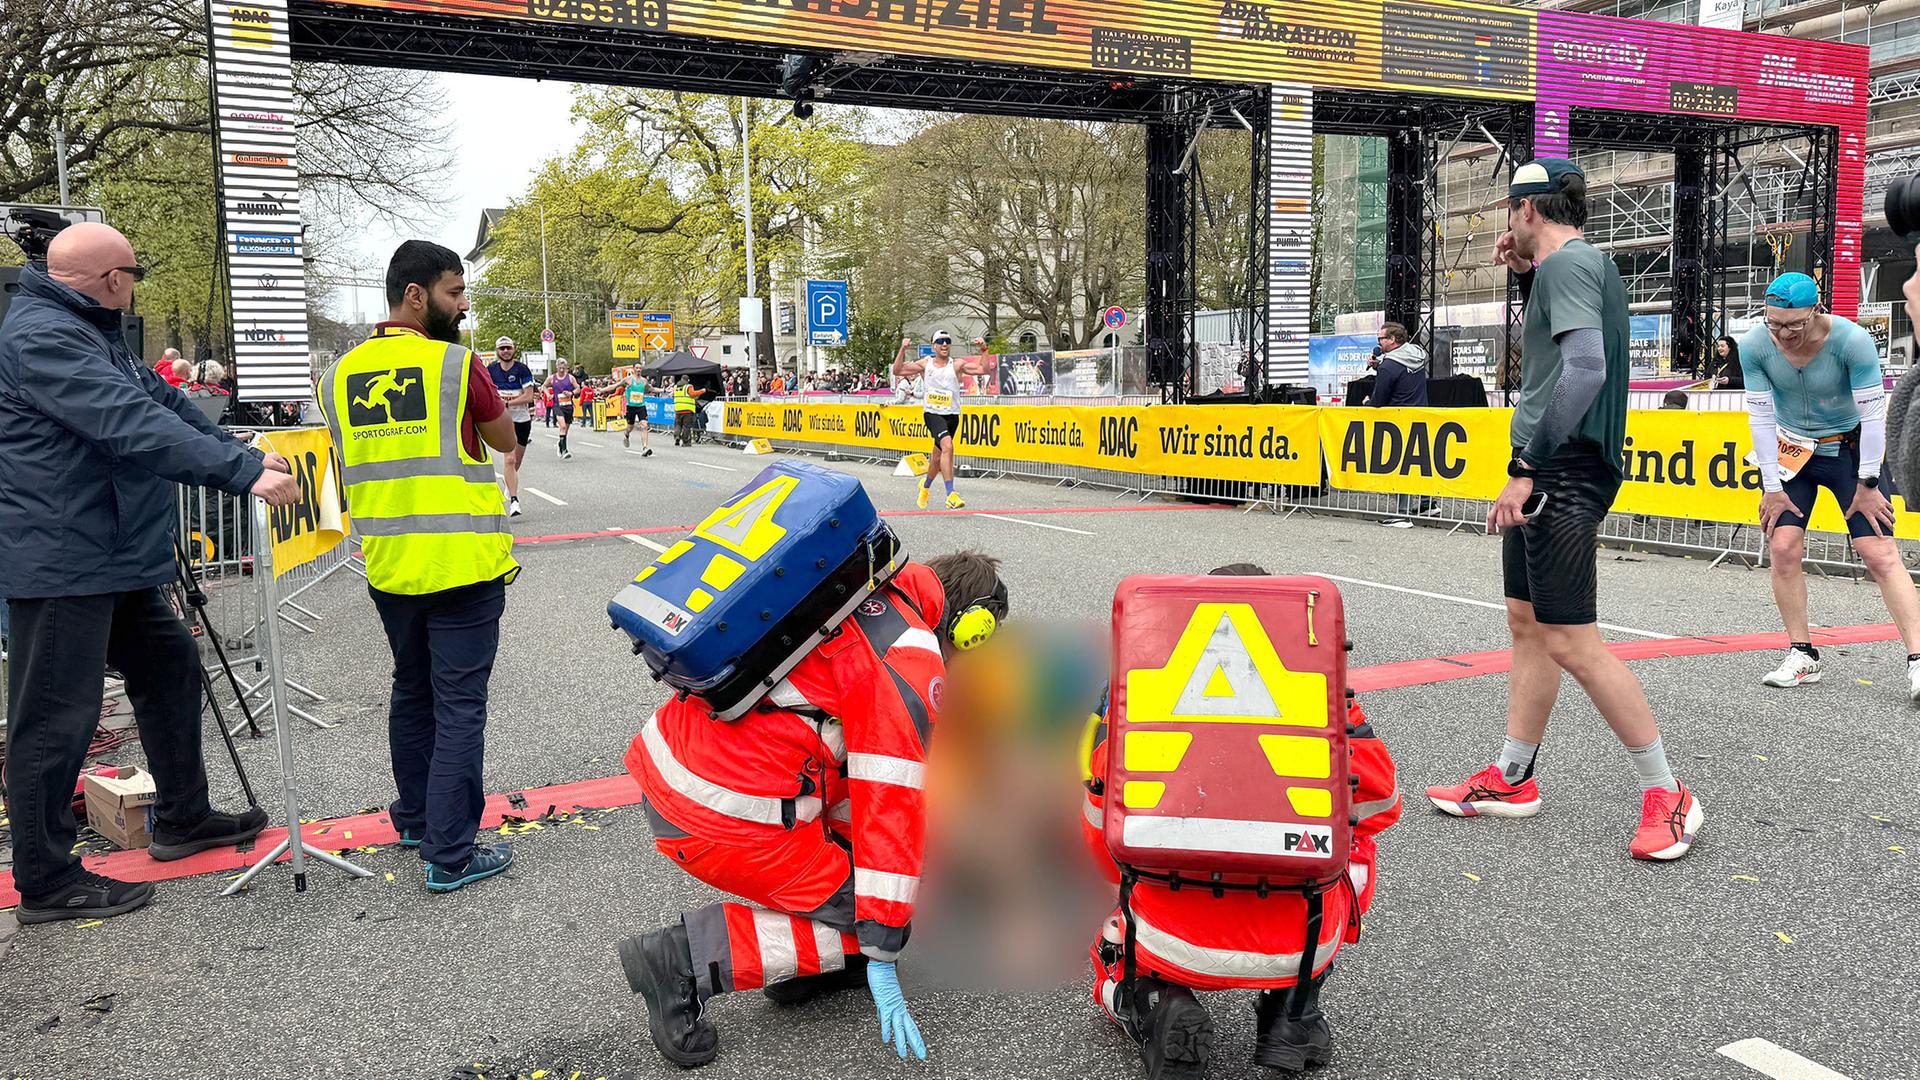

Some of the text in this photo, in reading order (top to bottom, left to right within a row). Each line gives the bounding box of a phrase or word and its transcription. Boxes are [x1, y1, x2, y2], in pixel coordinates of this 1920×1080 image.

[232, 9, 270, 24] ADAC
[1219, 2, 1271, 21] ADAC
[1241, 21, 1358, 48] MARATHON
[1287, 46, 1357, 63] HANNOVER
[1552, 38, 1648, 71] enercity
[616, 344, 636, 352] ADAC
[352, 425, 428, 441] SPORTOGRAF.COM
[726, 408, 743, 428] ADAC
[783, 409, 803, 432] ADAC
[809, 414, 821, 430] Wir
[822, 414, 835, 431] sind
[855, 411, 881, 438] ADAC
[889, 418, 906, 437] Wir
[960, 414, 1000, 447] ADAC
[1015, 421, 1036, 445] Wir
[1039, 421, 1066, 447] sind
[1069, 422, 1085, 448] da.
[1098, 416, 1139, 459] ADAC
[1159, 424, 1200, 457] Wir
[1203, 424, 1254, 460] sind
[1259, 426, 1299, 461] da.
[1341, 420, 1468, 480] ADAC
[1622, 436, 1696, 487] ind
[661, 611, 688, 633] PAX
[1284, 830, 1331, 854] PAX
